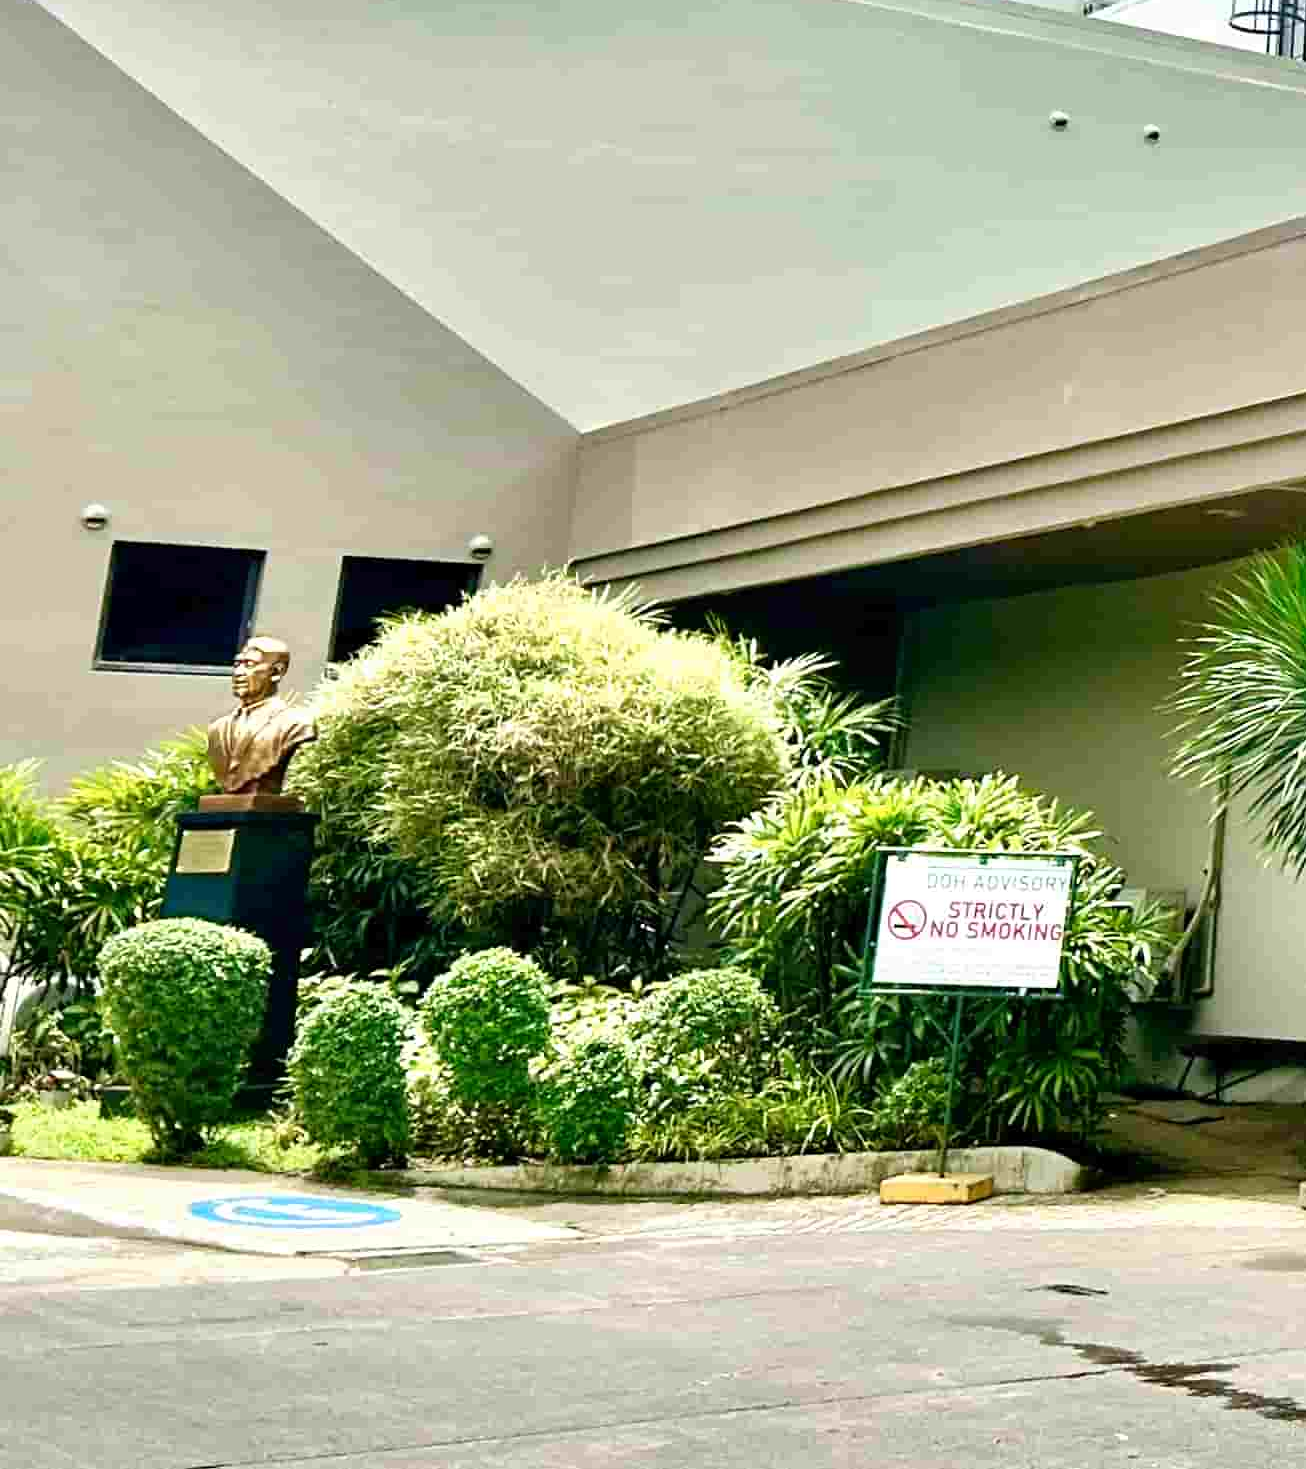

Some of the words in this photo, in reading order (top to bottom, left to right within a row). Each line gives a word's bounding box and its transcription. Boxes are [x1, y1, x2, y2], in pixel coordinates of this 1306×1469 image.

[927, 872, 966, 890] DOH
[973, 874, 1069, 893] ADVISORY
[947, 901, 1044, 921] STRICTLY
[929, 919, 960, 939] NO
[966, 922, 1063, 941] SMOKING
